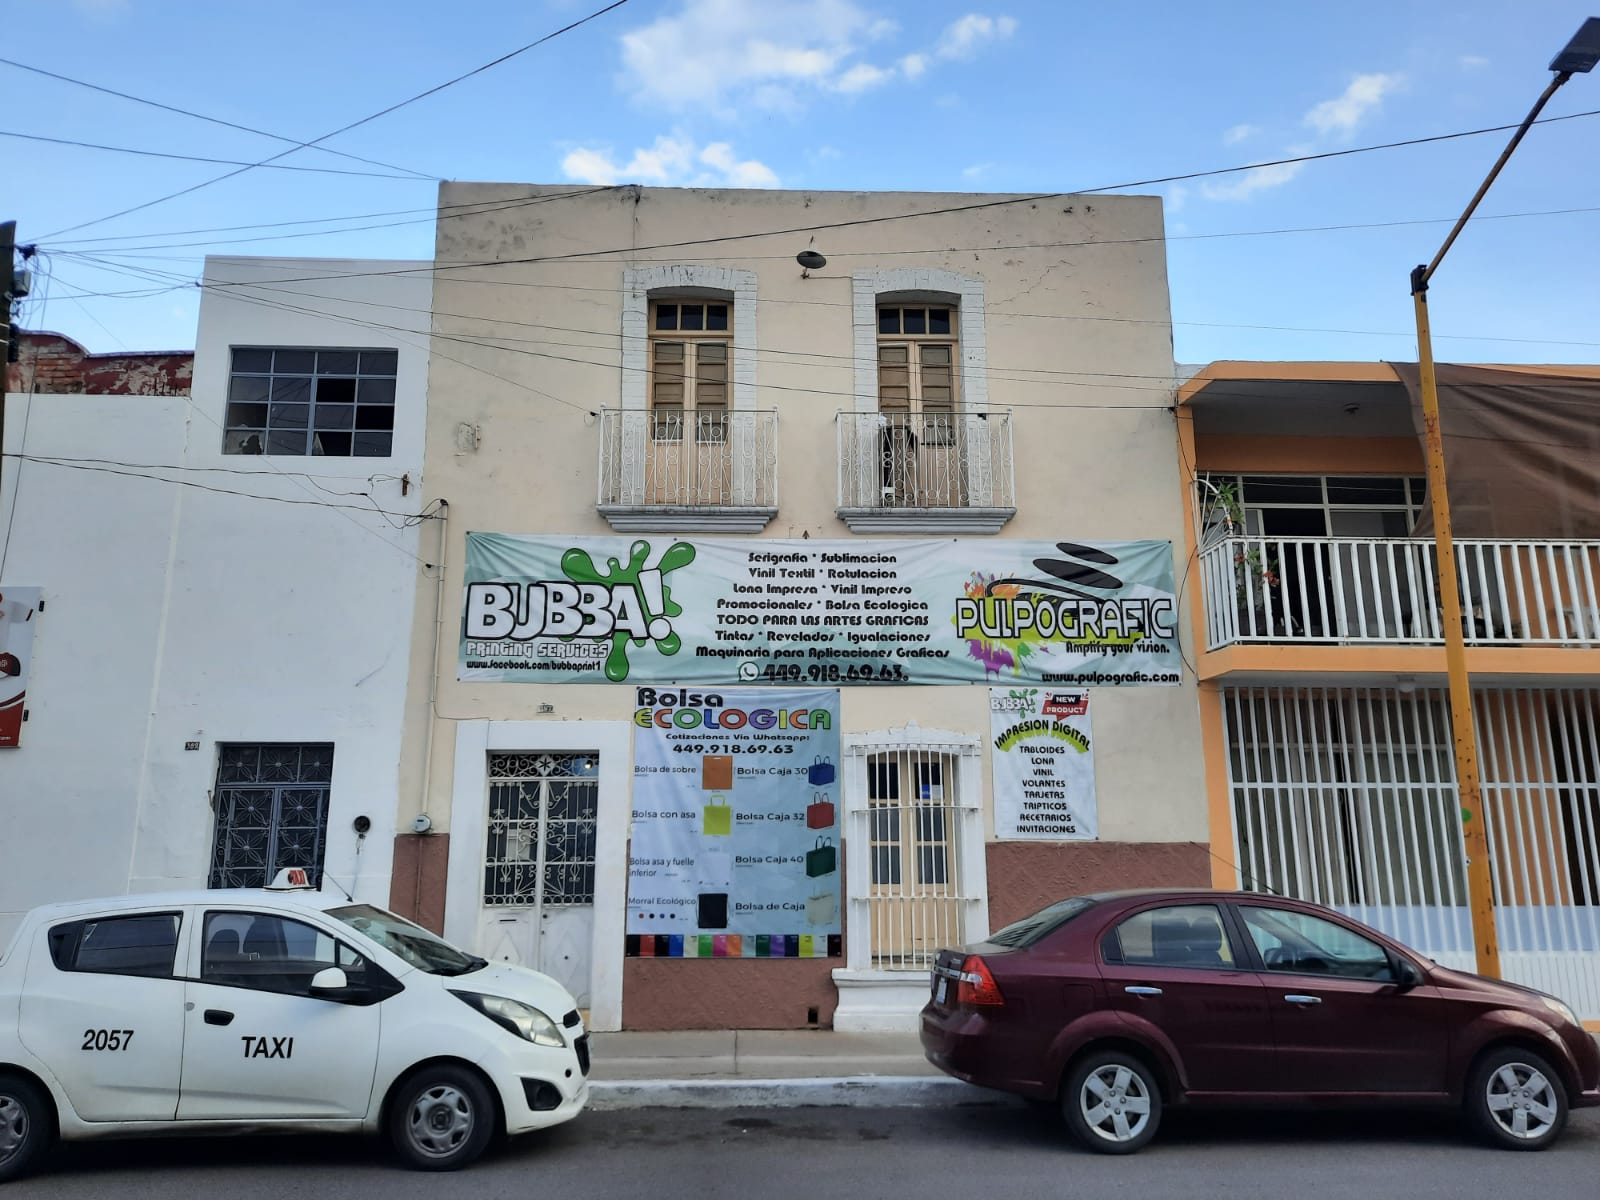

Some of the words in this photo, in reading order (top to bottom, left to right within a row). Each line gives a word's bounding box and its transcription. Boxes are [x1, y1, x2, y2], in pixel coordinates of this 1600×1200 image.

[748, 552, 808, 565] Serigrafia
[820, 553, 897, 564] Sublimacion
[748, 567, 776, 578] Vinil
[779, 568, 815, 579] Textil
[827, 568, 897, 579] Rotulacion
[733, 583, 763, 594] Lona
[766, 584, 818, 597] Impresa
[830, 584, 858, 595] Vinil
[861, 584, 912, 597] Impreso
[464, 567, 672, 641] BUBBA!
[716, 598, 813, 611] Promocionales
[825, 600, 860, 611] Bolsa
[863, 600, 929, 613] Ecologica
[716, 614, 759, 626] TODO
[762, 615, 797, 626] PARA
[800, 615, 820, 626] LAS
[823, 615, 862, 626] ARTES
[865, 615, 929, 626] GRAFICAS
[955, 597, 1174, 639] PULPOGRAFIC
[714, 630, 755, 641] Tintas
[766, 631, 835, 642] Revelados
[847, 632, 931, 644] Igualaciones
[695, 646, 770, 660] Maquinaria
[773, 649, 805, 660] para
[808, 647, 892, 660] Aplicaciones
[895, 647, 950, 658] Graficas
[1065, 641, 1107, 656] Amplify
[1111, 644, 1133, 656] your
[1135, 642, 1170, 654] vision.
[466, 660, 601, 672] www.facebook.com/bubbaprint1
[1041, 671, 1180, 685] www.pulpografic.com
[637, 687, 724, 708] Bolsa
[634, 708, 831, 730] ECOLOGICA
[665, 733, 730, 741] Cotizaciones
[753, 733, 810, 743] Whatsapp:
[994, 719, 1049, 750] IMPRESION
[1052, 721, 1091, 751] DIGITAL
[673, 744, 794, 754] 449.918.69.63
[1019, 746, 1065, 754] TABLOIDES
[1031, 757, 1054, 765] LONA
[634, 765, 658, 774] Bolsa
[660, 765, 670, 774] de
[672, 766, 697, 774] sobre
[737, 767, 766, 776] Bolsa
[768, 767, 792, 777] Caja
[794, 767, 808, 775] 30
[1022, 780, 1066, 788] VOLANTES
[1024, 791, 1065, 799] TARJETAS
[1023, 802, 1067, 810] TRIPTICOS
[631, 810, 658, 819] Bolsa
[660, 811, 679, 819] con
[680, 811, 696, 819] asa
[736, 813, 764, 821] Bolsa
[767, 813, 790, 823] Caja
[792, 813, 805, 821] 32
[1019, 813, 1072, 822] RECETARIOS
[1016, 825, 1076, 833] INVITACIONES
[630, 857, 650, 866] Bolsa
[651, 858, 665, 866] asa
[666, 858, 672, 867] y
[672, 857, 695, 866] fuelle
[735, 855, 763, 864] Bolsa
[765, 855, 788, 865] Caja
[790, 855, 804, 864] 40
[628, 897, 655, 905] Morral
[735, 902, 764, 911] Bolsa
[765, 902, 780, 911] de
[782, 902, 805, 912] Caja
[81, 1028, 135, 1051] 2057
[241, 1036, 294, 1059] TAXI
